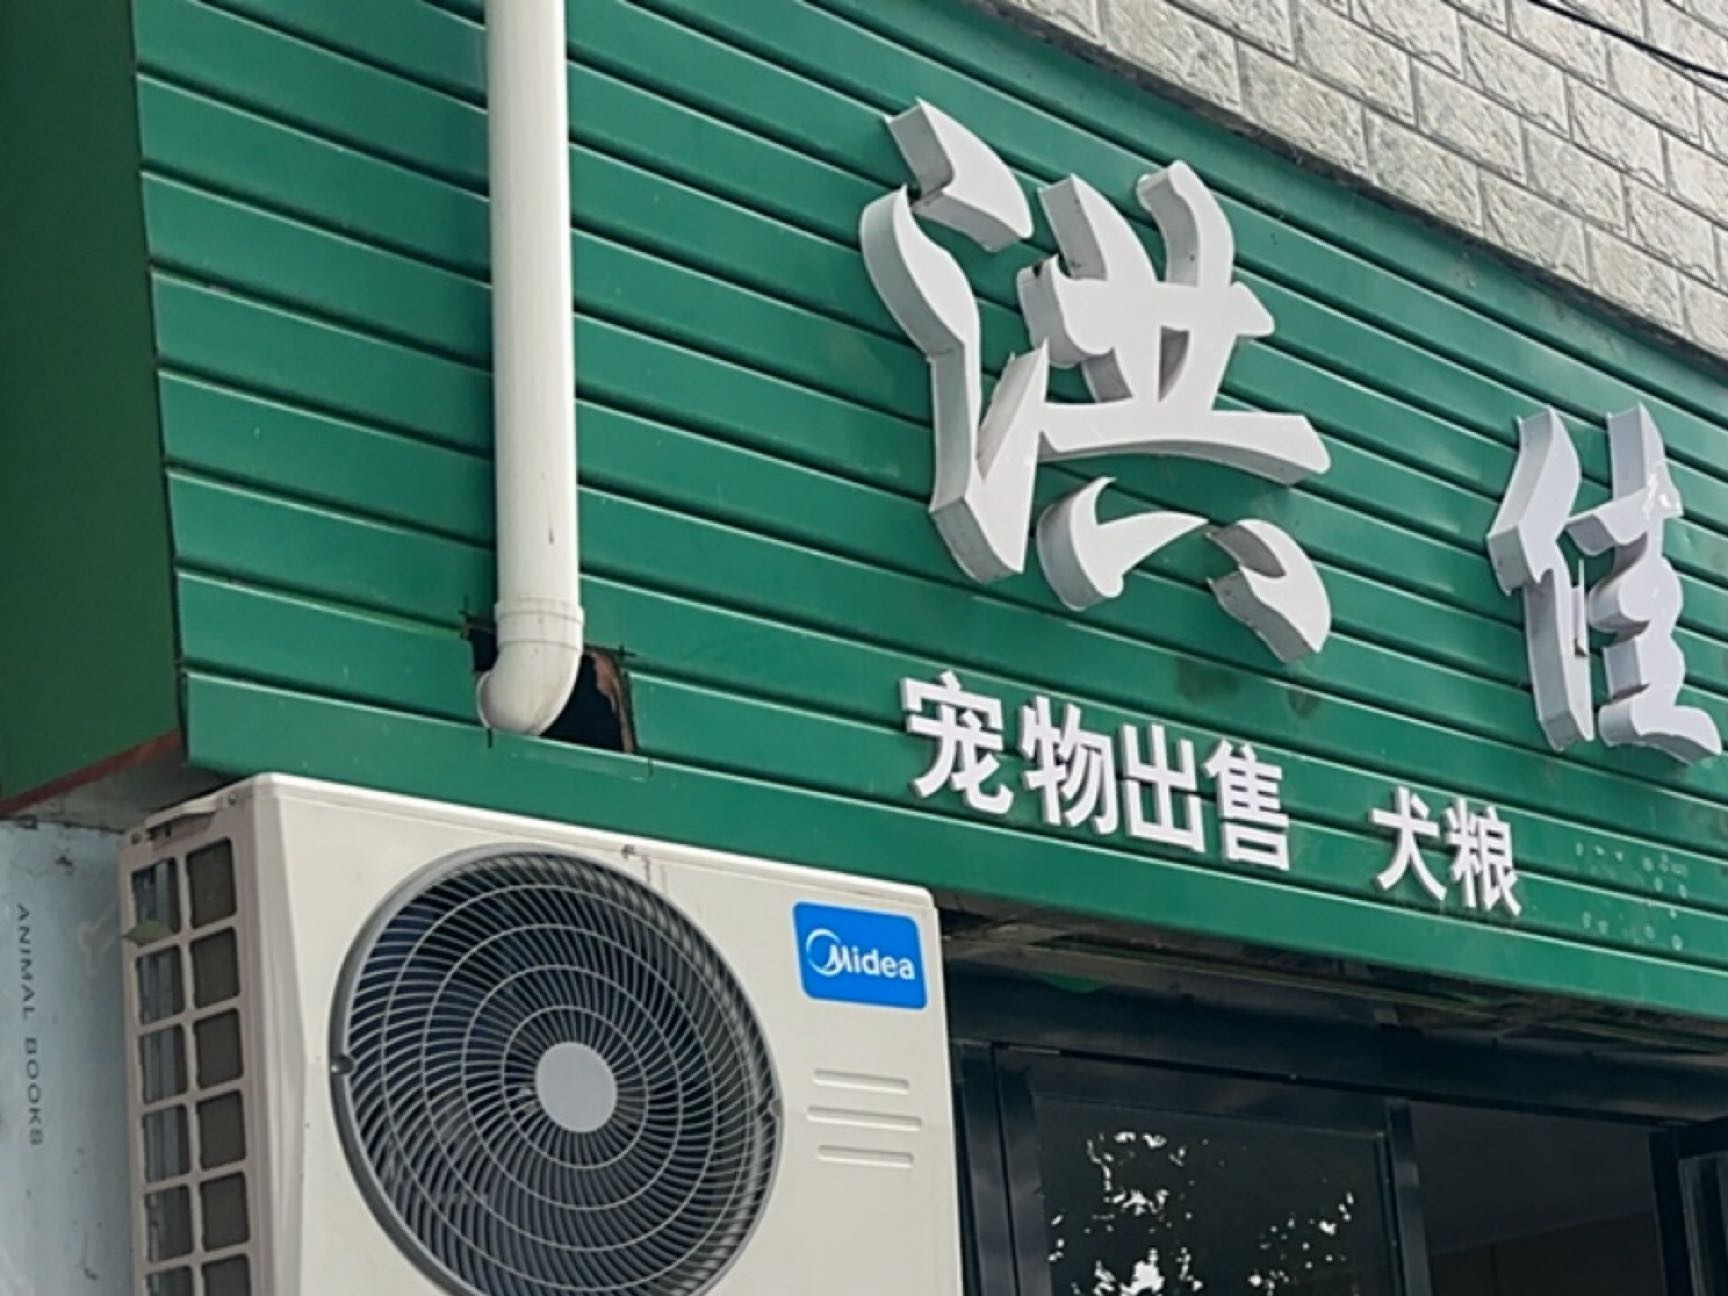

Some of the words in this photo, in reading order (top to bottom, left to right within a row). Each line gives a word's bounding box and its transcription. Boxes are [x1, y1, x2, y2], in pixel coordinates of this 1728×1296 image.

[900, 670, 1291, 871] 宠物出售
[1370, 786, 1522, 916] 犬粮
[16, 903, 36, 1021] ANIMAL
[806, 928, 916, 980] Midea
